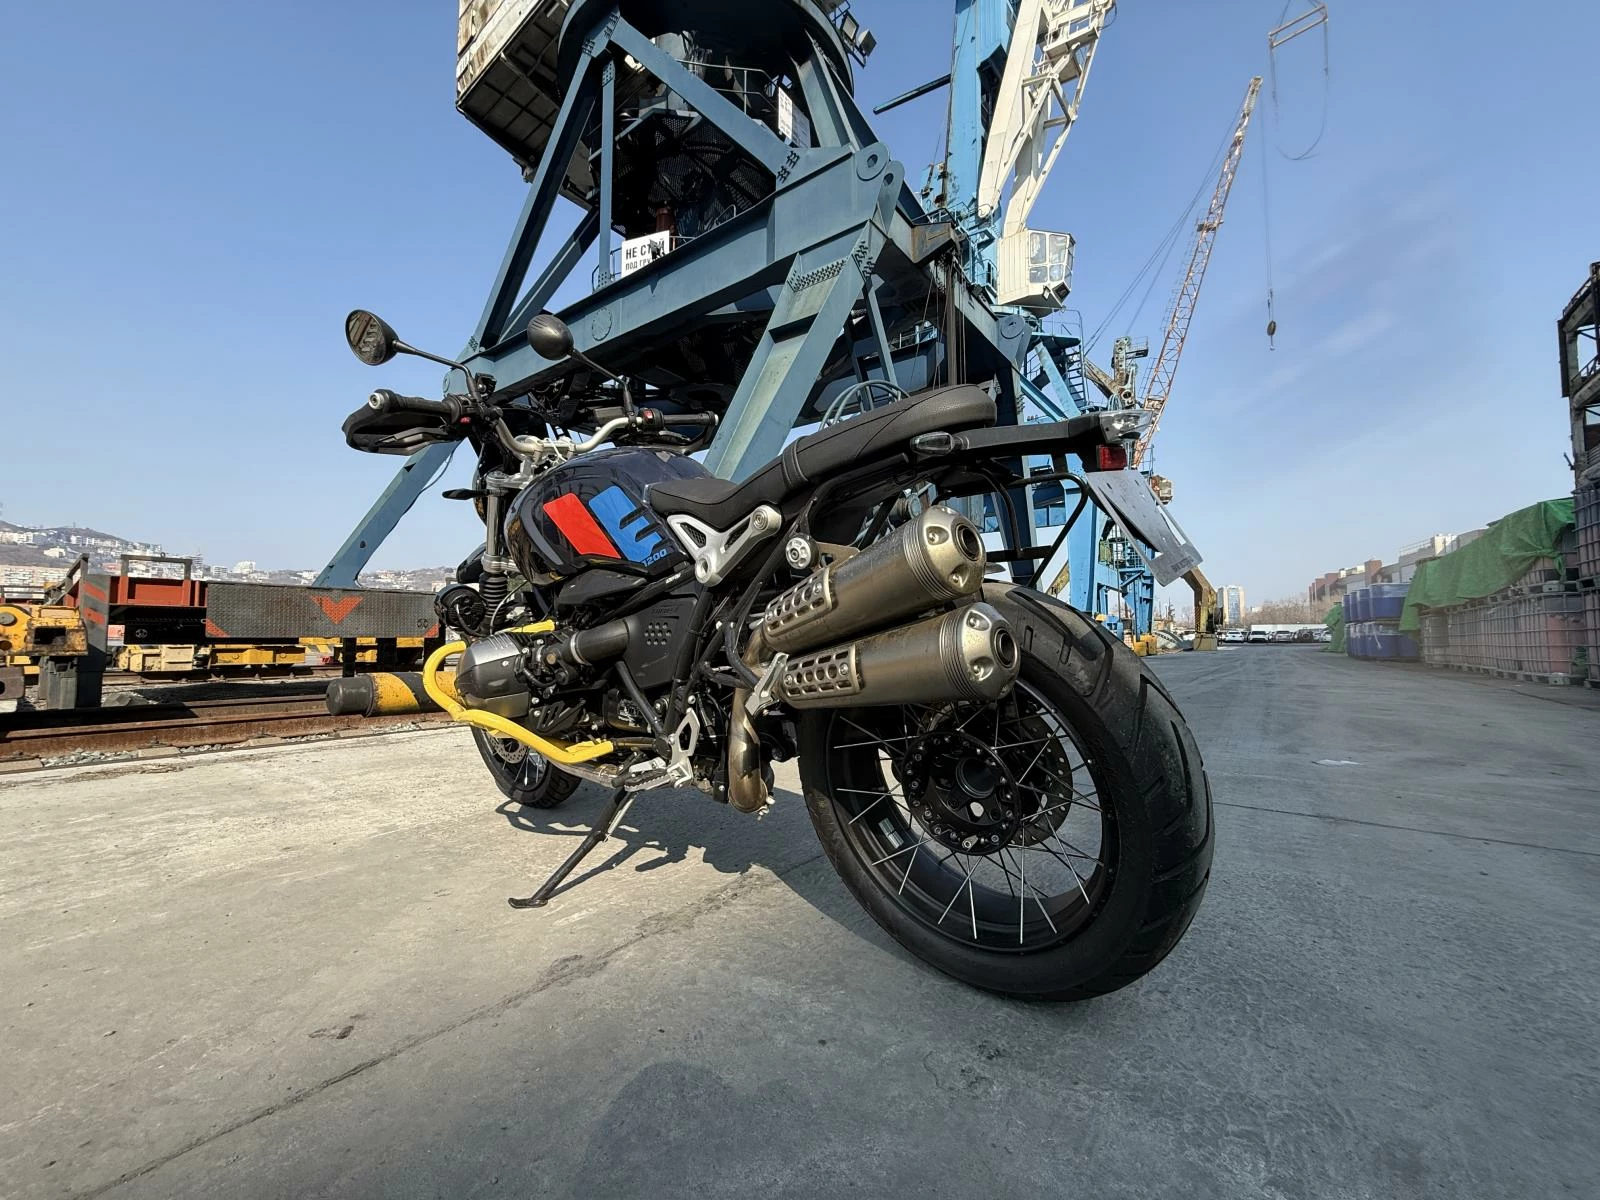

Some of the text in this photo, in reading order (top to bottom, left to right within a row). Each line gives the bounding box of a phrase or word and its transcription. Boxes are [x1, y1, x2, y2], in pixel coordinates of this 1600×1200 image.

[625, 238, 665, 260] НЕ СТЙ
[641, 549, 667, 567] 1200
